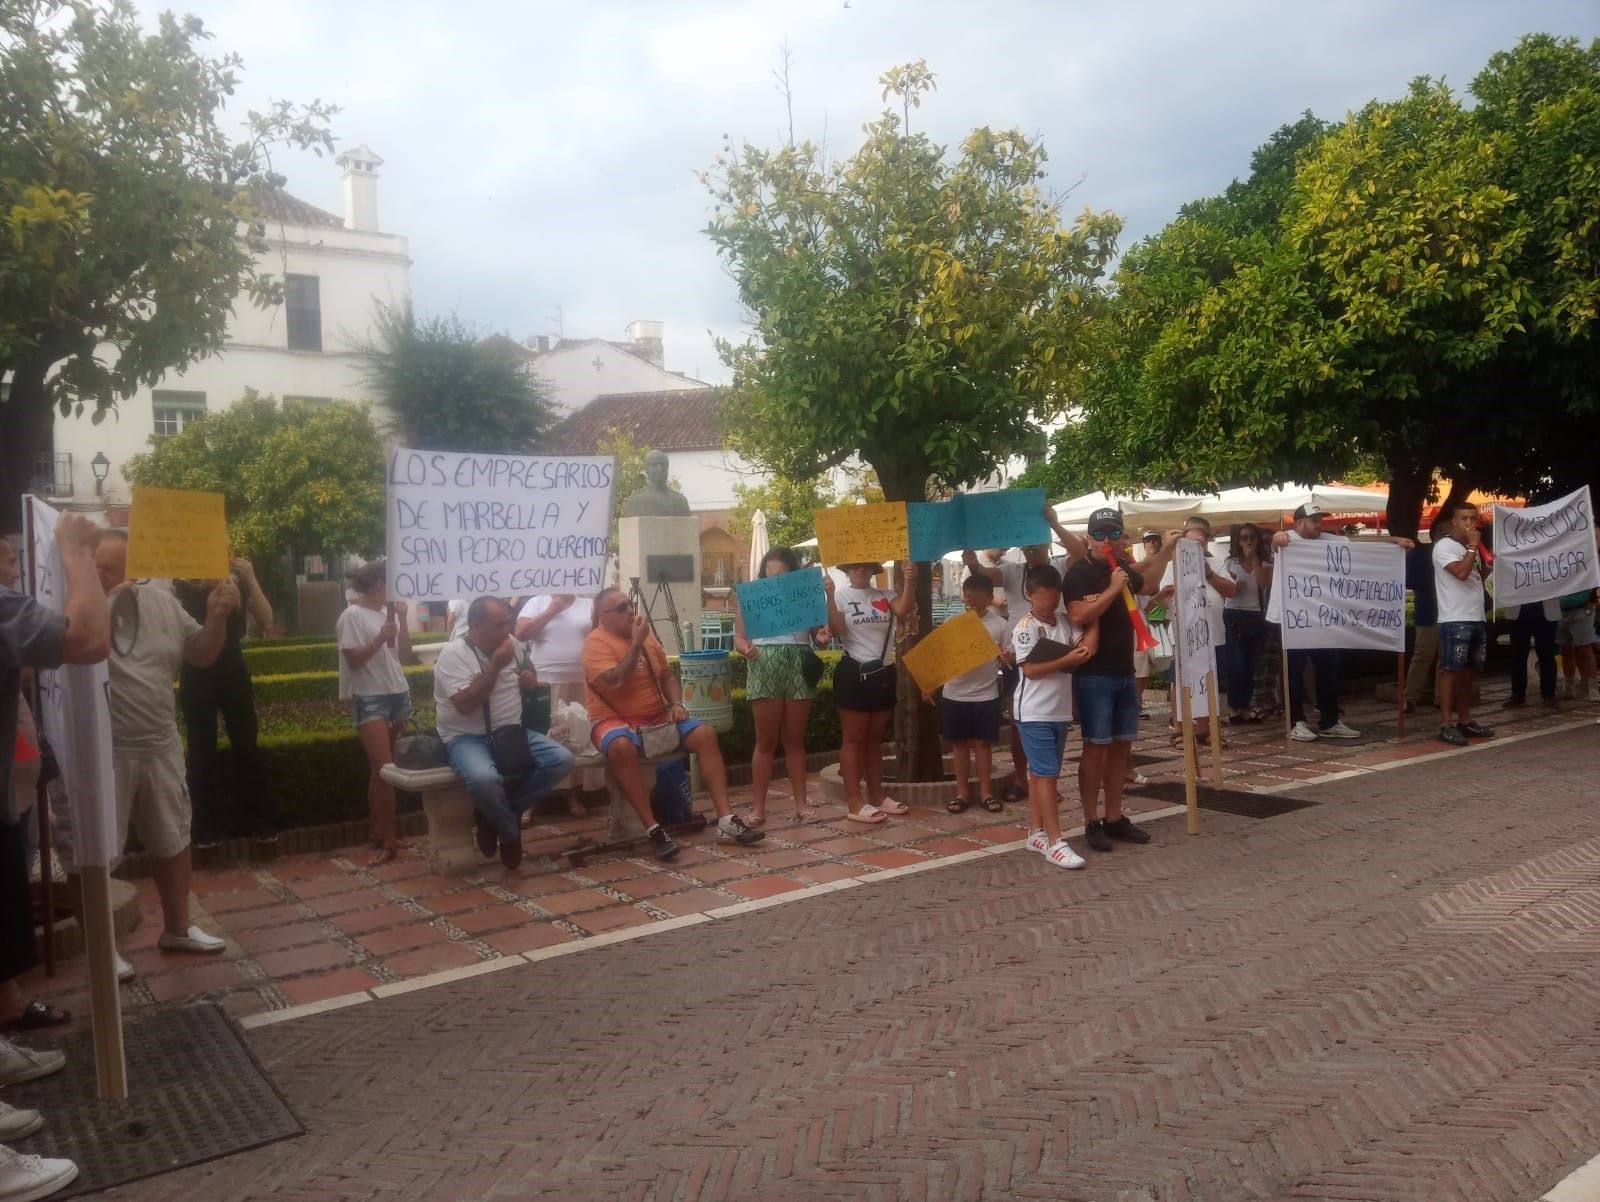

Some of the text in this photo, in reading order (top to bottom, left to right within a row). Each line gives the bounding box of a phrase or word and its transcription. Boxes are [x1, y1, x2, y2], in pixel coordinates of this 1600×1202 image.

[389, 451, 612, 489] LOS EMPRESARIOS
[397, 498, 590, 531] DE MARBELLA Y
[1503, 500, 1589, 549] QUEREMOS
[400, 535, 609, 565] SAN PEDRO QUEREMOS
[1326, 544, 1351, 575] NO
[395, 567, 601, 598] QUE NOS ESCUCHEN
[1514, 551, 1587, 589] DIALOGAR
[1288, 575, 1402, 601] A LA MODIFICACIÓN
[847, 601, 865, 617] I
[1286, 604, 1401, 629] DEL PLAN DE PLAYAS
